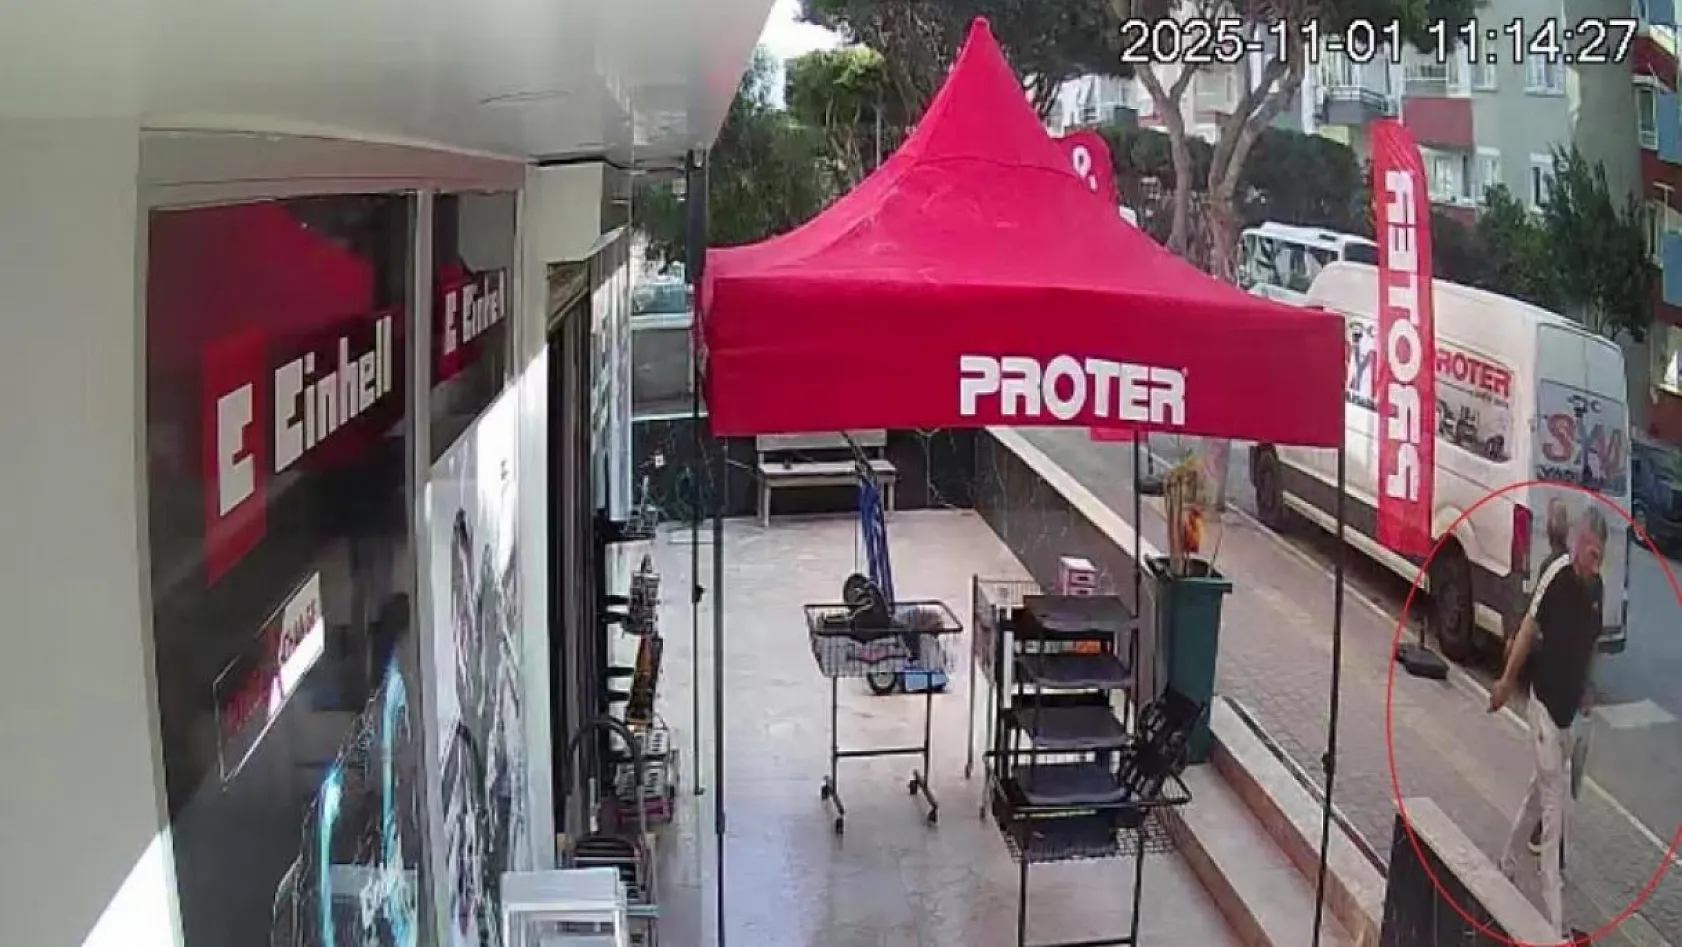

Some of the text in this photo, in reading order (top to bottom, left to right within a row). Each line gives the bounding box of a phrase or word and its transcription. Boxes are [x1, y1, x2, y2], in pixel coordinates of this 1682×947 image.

[275, 315, 392, 474] Einhell
[960, 354, 1186, 425] PROTER
[1436, 348, 1512, 398] ROTER
